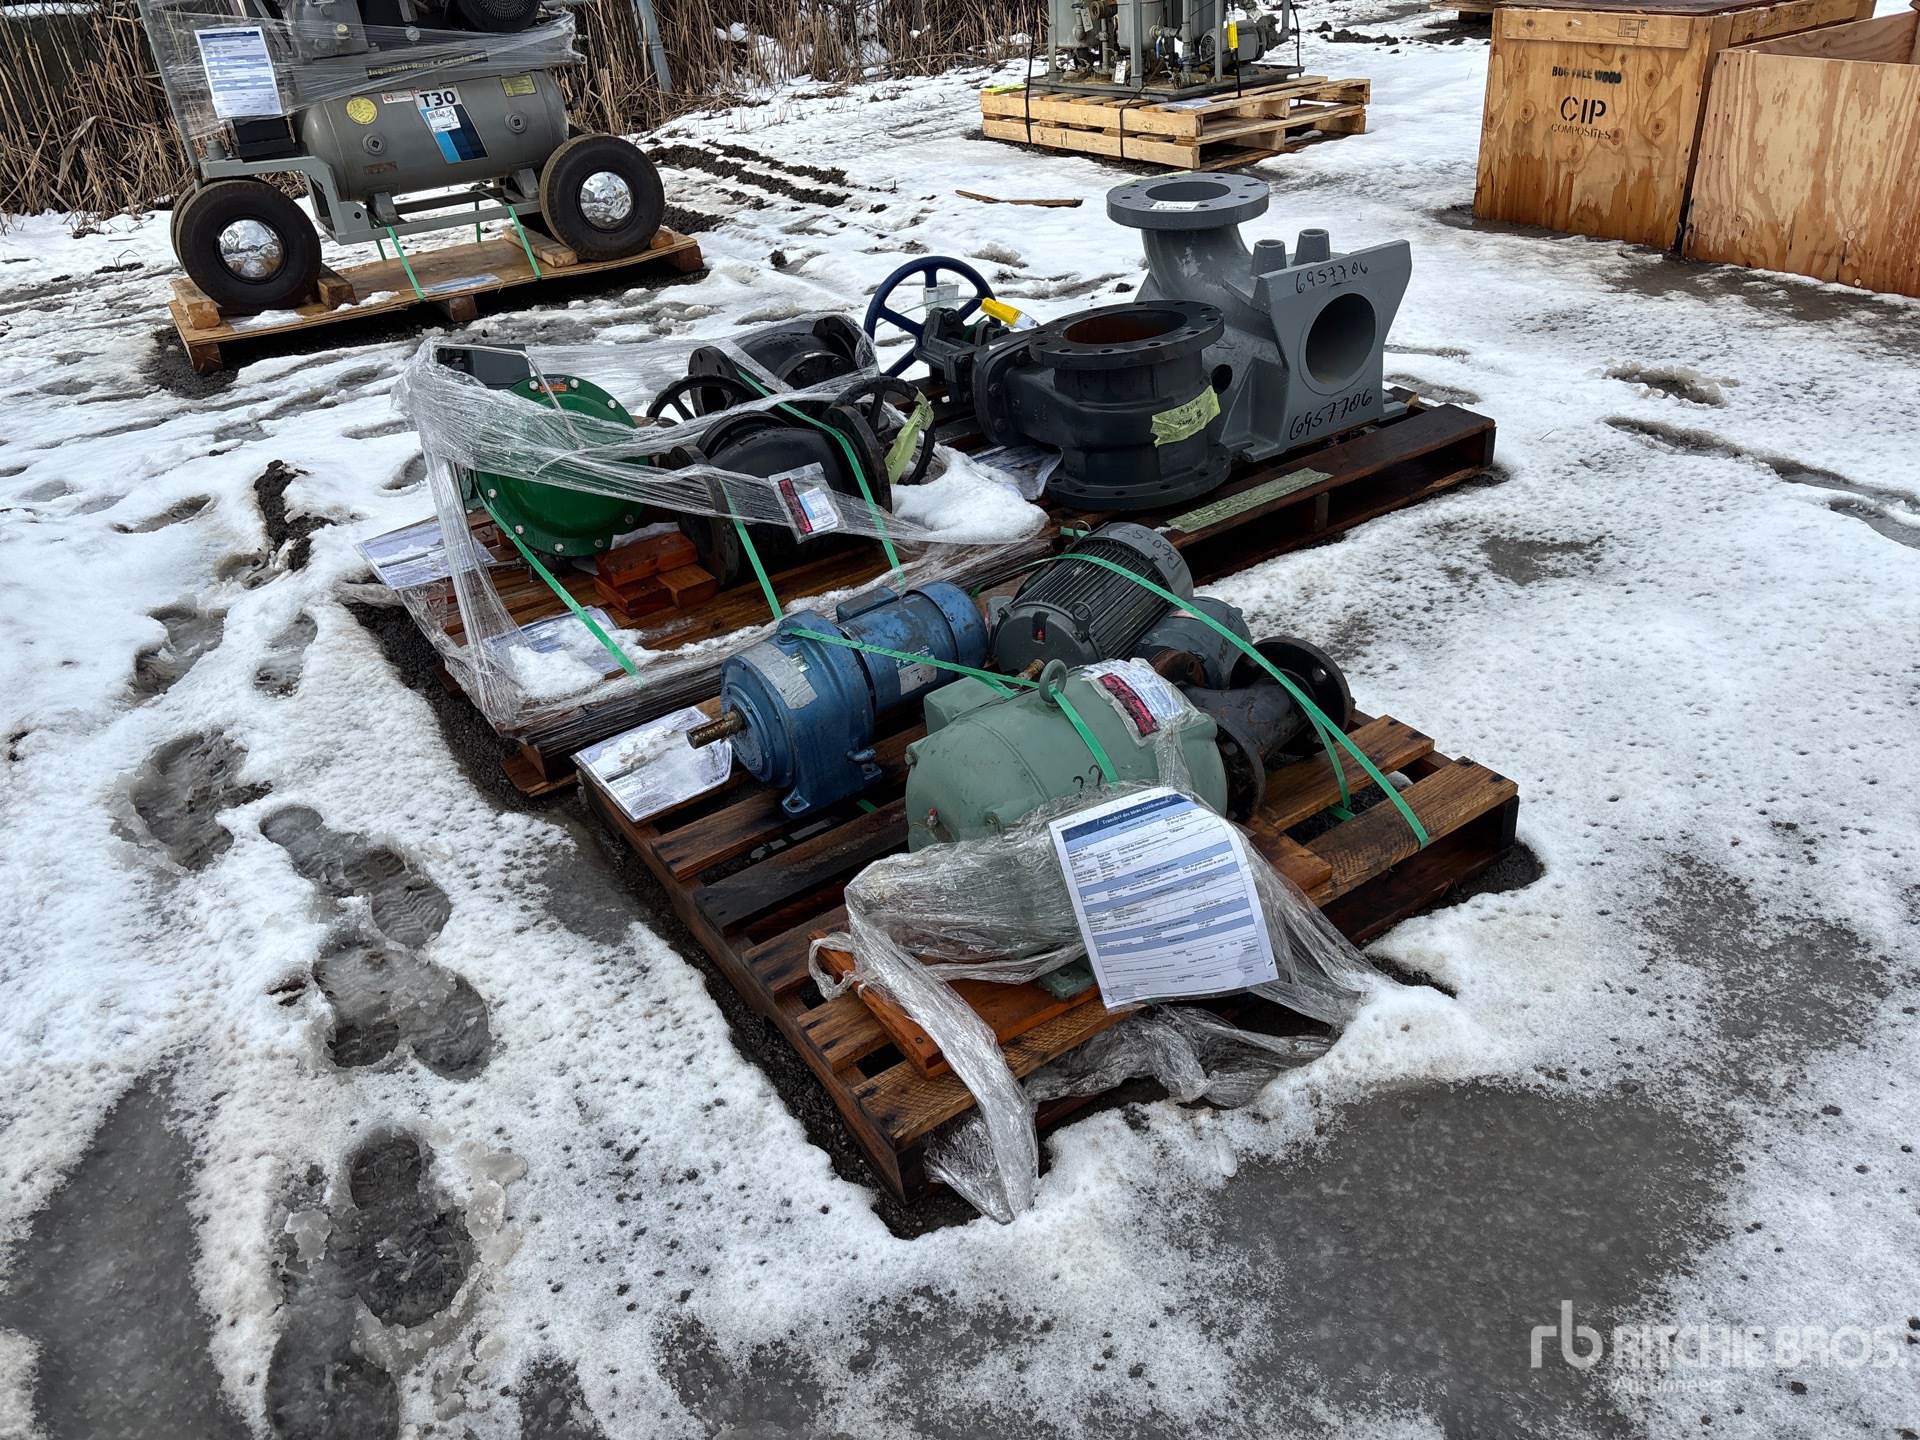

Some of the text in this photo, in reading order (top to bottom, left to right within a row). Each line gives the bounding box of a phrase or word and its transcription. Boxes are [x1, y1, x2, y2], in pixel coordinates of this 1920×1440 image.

[1552, 66, 1569, 77] BUG
[419, 90, 456, 108] T30
[1560, 96, 1606, 124] CIP
[1551, 123, 1611, 140] COMPOSITES
[1295, 261, 1369, 294] 6957706
[1289, 388, 1373, 441] 6957706
